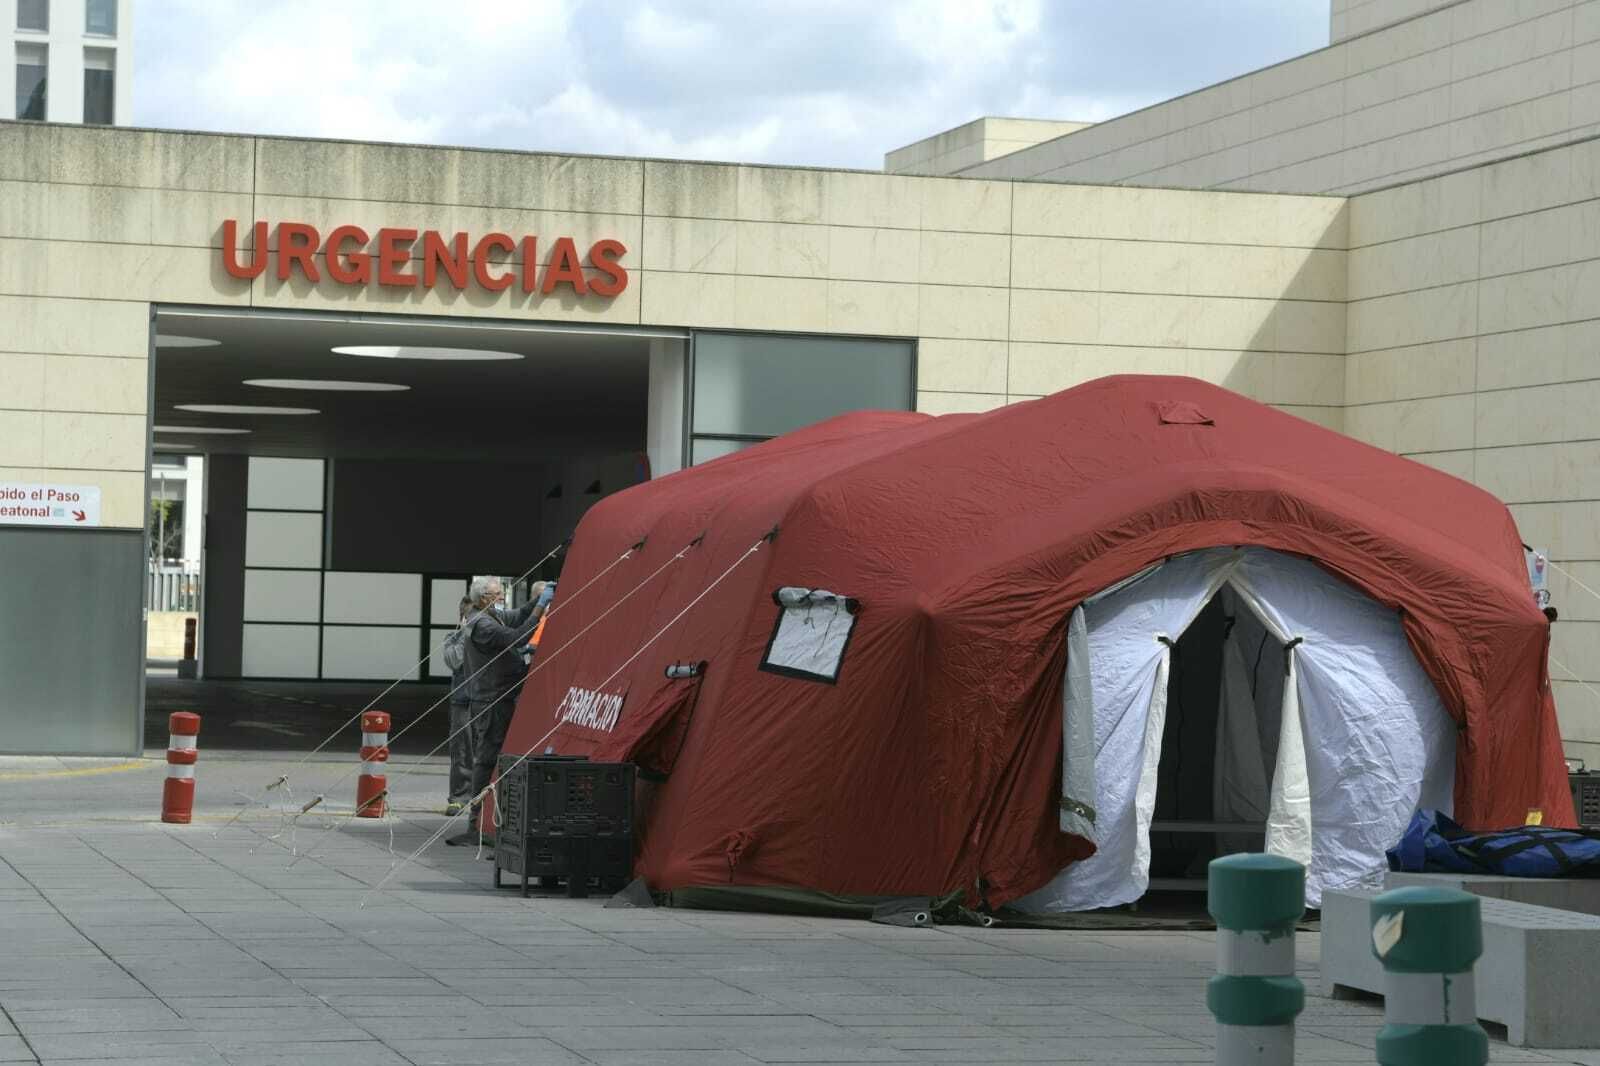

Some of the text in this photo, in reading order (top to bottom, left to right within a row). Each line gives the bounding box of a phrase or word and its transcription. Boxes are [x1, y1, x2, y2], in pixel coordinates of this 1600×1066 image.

[222, 219, 629, 297] URGENCIAS
[31, 489, 42, 501] el
[47, 488, 80, 502] Paso
